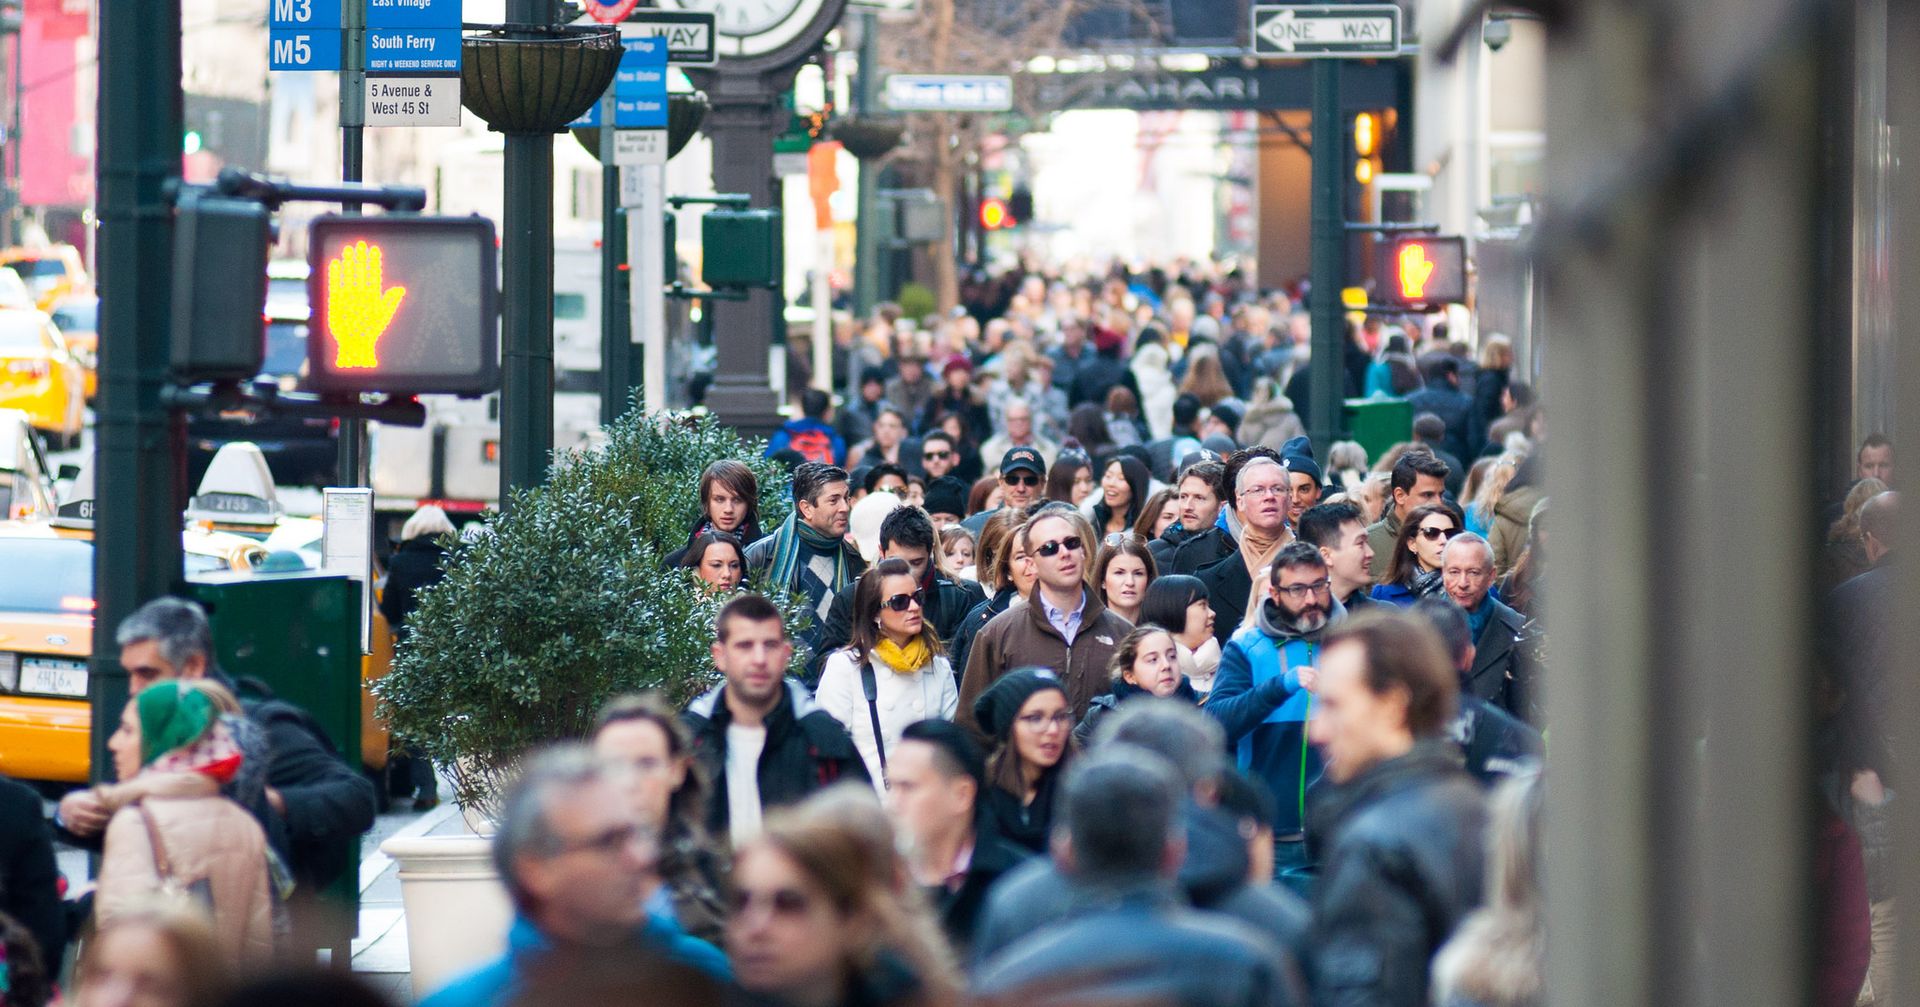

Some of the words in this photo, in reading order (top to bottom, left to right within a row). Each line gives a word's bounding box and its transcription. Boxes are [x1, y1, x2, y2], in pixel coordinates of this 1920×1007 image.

[274, 0, 312, 22] M3
[1270, 22, 1315, 39] ONE
[1342, 22, 1385, 39] WAY
[274, 35, 312, 64] M5
[371, 35, 403, 49] South
[406, 35, 436, 51] Ferry
[371, 60, 387, 68] NIGHT
[394, 60, 420, 68] WEEKEND
[420, 60, 443, 68] SERVICE
[443, 60, 457, 68] ONLY
[371, 84, 378, 97] 5
[381, 84, 421, 97] Avenue
[424, 84, 432, 97] &
[371, 102, 399, 115] West
[402, 102, 415, 115] 45
[418, 102, 430, 115] St
